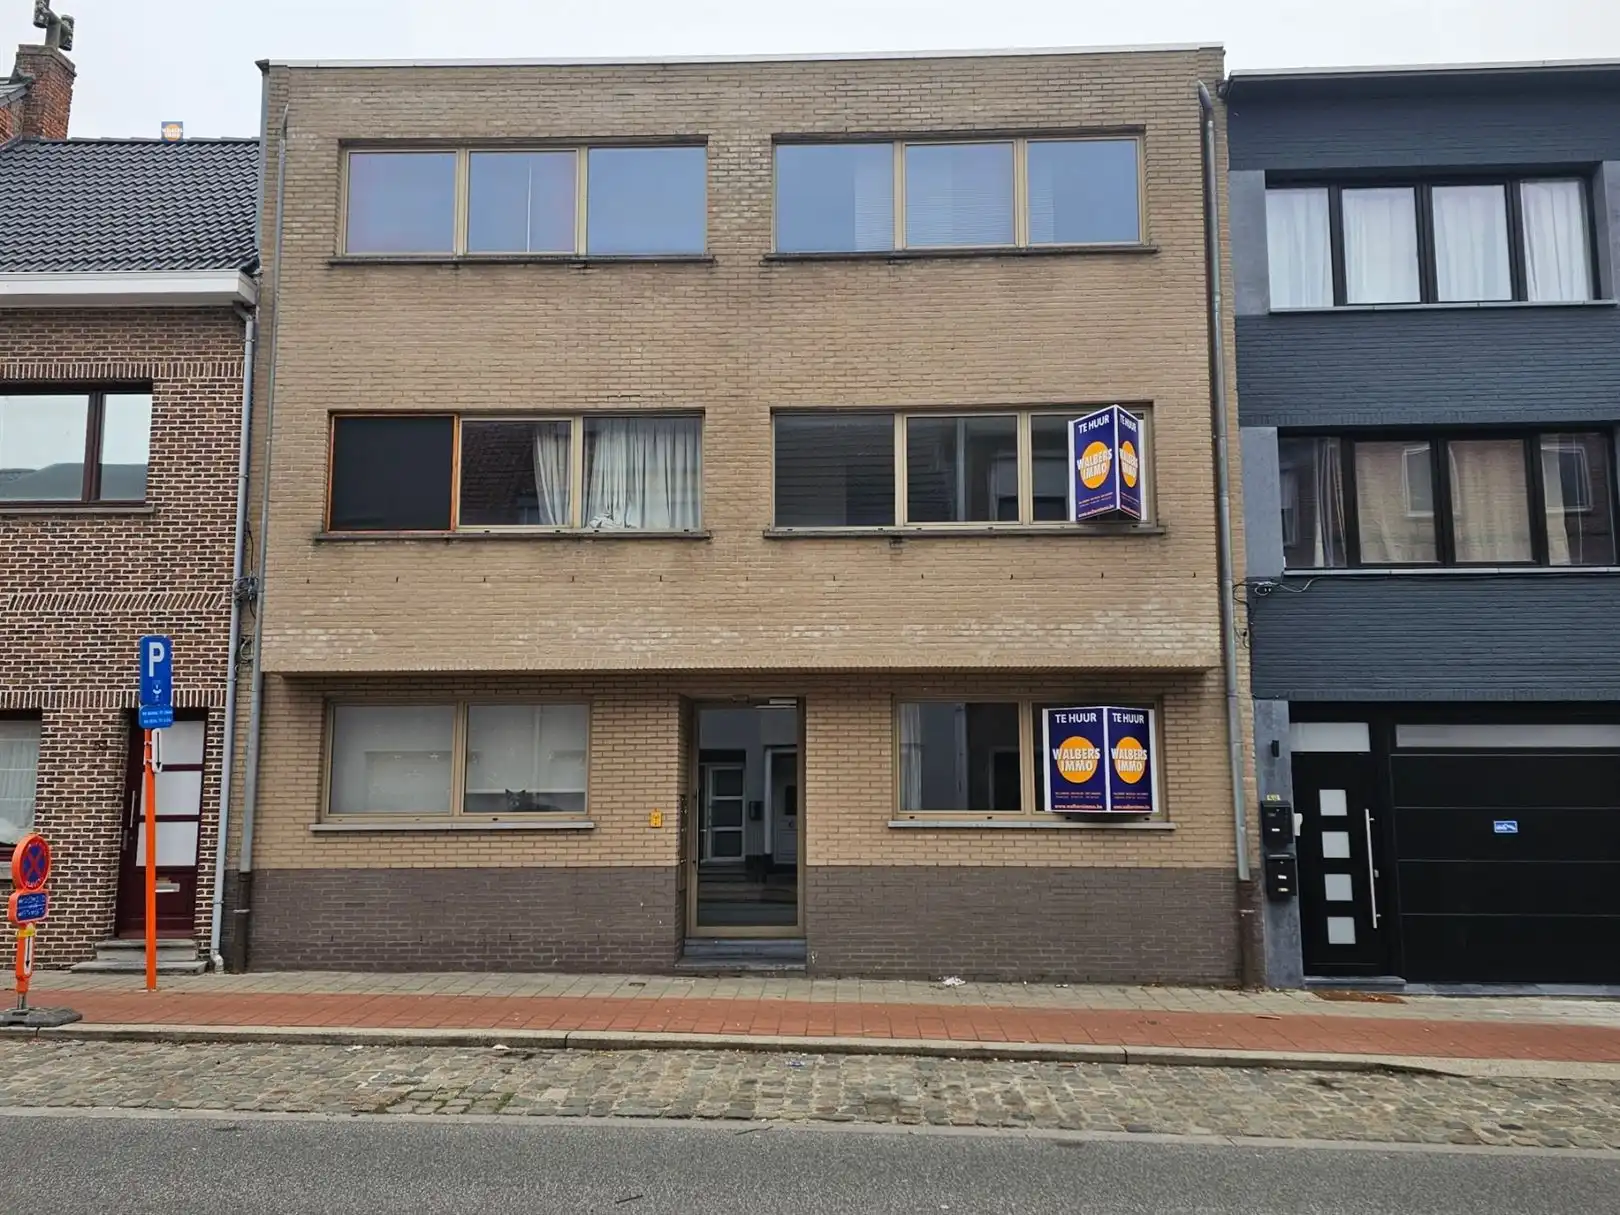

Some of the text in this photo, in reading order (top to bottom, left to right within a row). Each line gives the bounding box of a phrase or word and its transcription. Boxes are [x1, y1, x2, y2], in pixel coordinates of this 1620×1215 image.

[1078, 415, 1110, 434] TE HUUR
[1119, 414, 1136, 432] TE HUUR
[1077, 448, 1112, 470] WALBERS
[1083, 462, 1107, 480] IMMO
[148, 641, 165, 678] P
[1055, 712, 1097, 723] TE HUUR
[1112, 712, 1144, 724] TE HUUR
[1052, 748, 1101, 760] WALBERS
[1111, 748, 1148, 760] WALBERS
[1061, 760, 1093, 772] IMMO
[1118, 760, 1143, 772] IMMO
